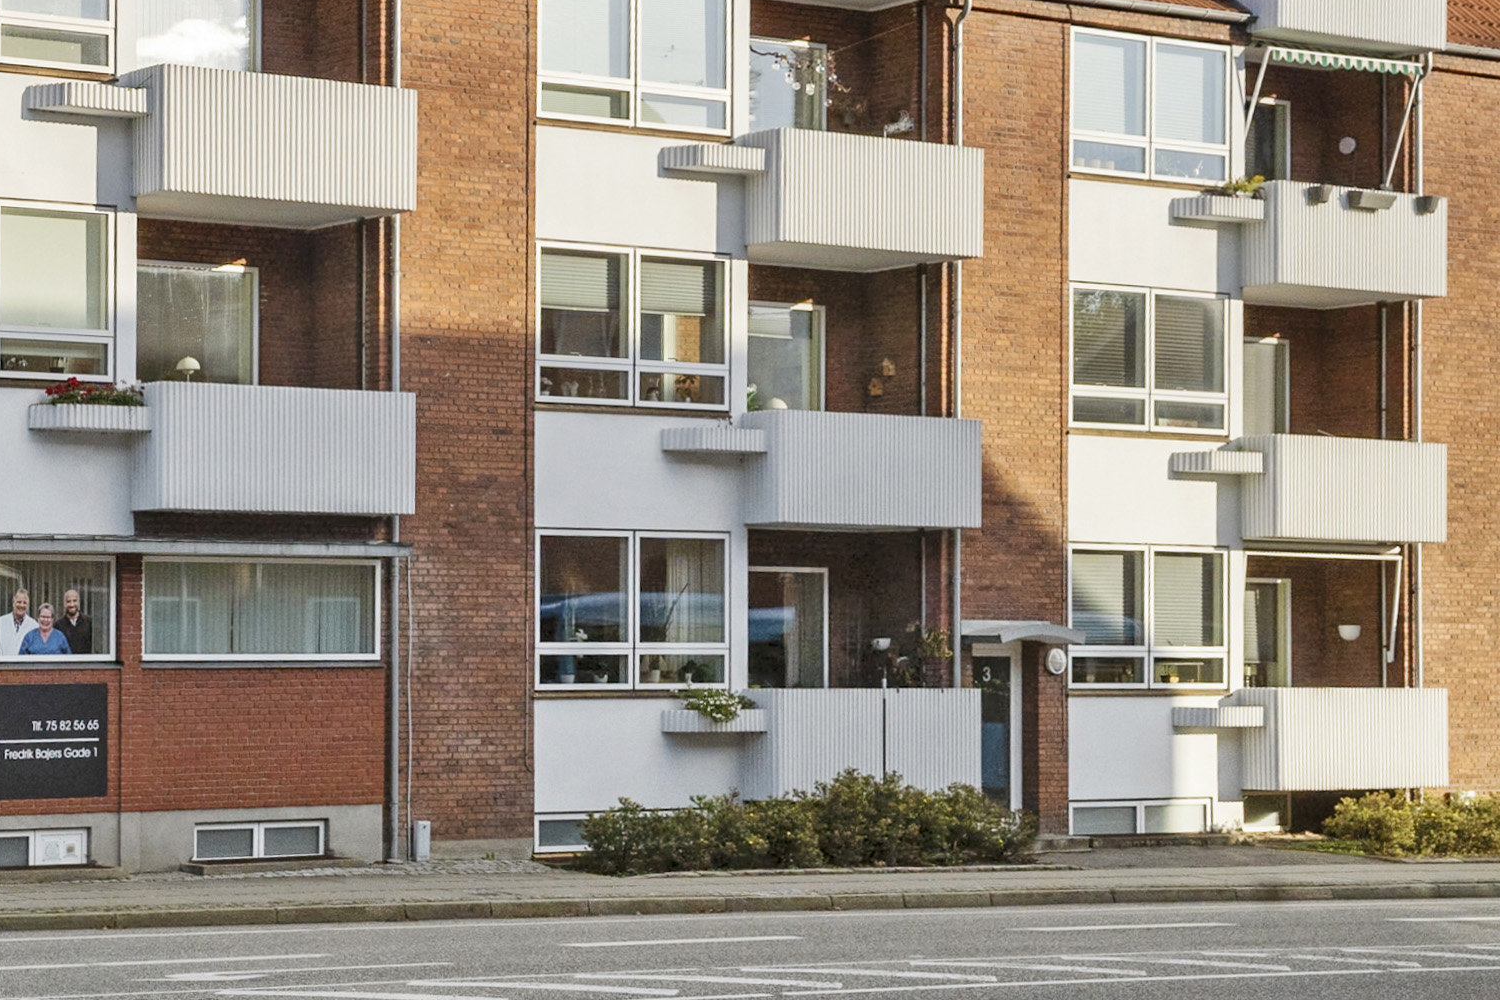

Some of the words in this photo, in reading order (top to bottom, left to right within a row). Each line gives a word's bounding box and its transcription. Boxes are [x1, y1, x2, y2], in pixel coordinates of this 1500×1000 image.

[982, 666, 991, 682] 3
[45, 720, 58, 732] 75
[73, 719, 86, 731] 56
[87, 719, 100, 731] 65
[35, 748, 62, 760] Bajers
[63, 747, 91, 758] Gade
[93, 746, 98, 757] 1
